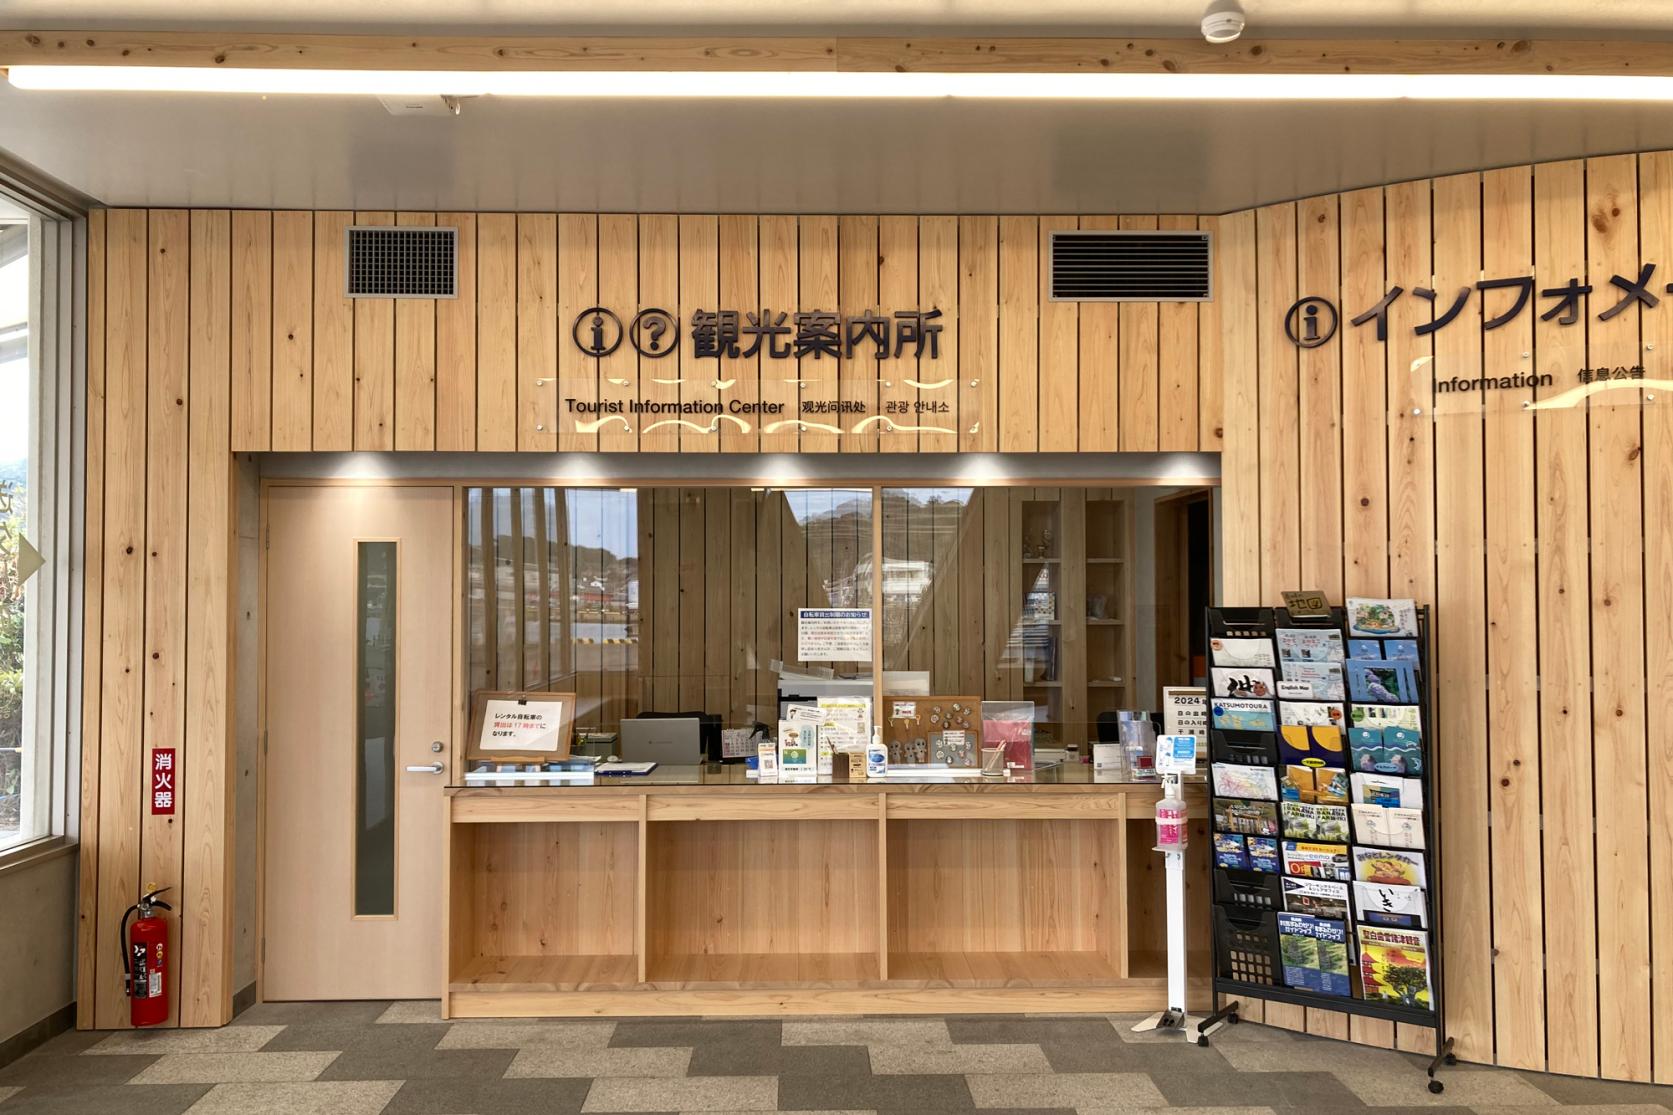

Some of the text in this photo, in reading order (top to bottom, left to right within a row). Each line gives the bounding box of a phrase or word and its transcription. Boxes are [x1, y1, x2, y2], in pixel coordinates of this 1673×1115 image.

[1351, 263, 1673, 341] インフォメ
[691, 308, 943, 359] 観光案内所
[1434, 371, 1553, 393] Information
[1577, 365, 1646, 384] 信息公告
[565, 398, 785, 415] Tourist Information Center
[802, 400, 867, 414] 观光问讯处
[885, 400, 950, 414] 관광 안내소
[1174, 696, 1200, 705] 2024
[154, 752, 173, 809] 消火器
